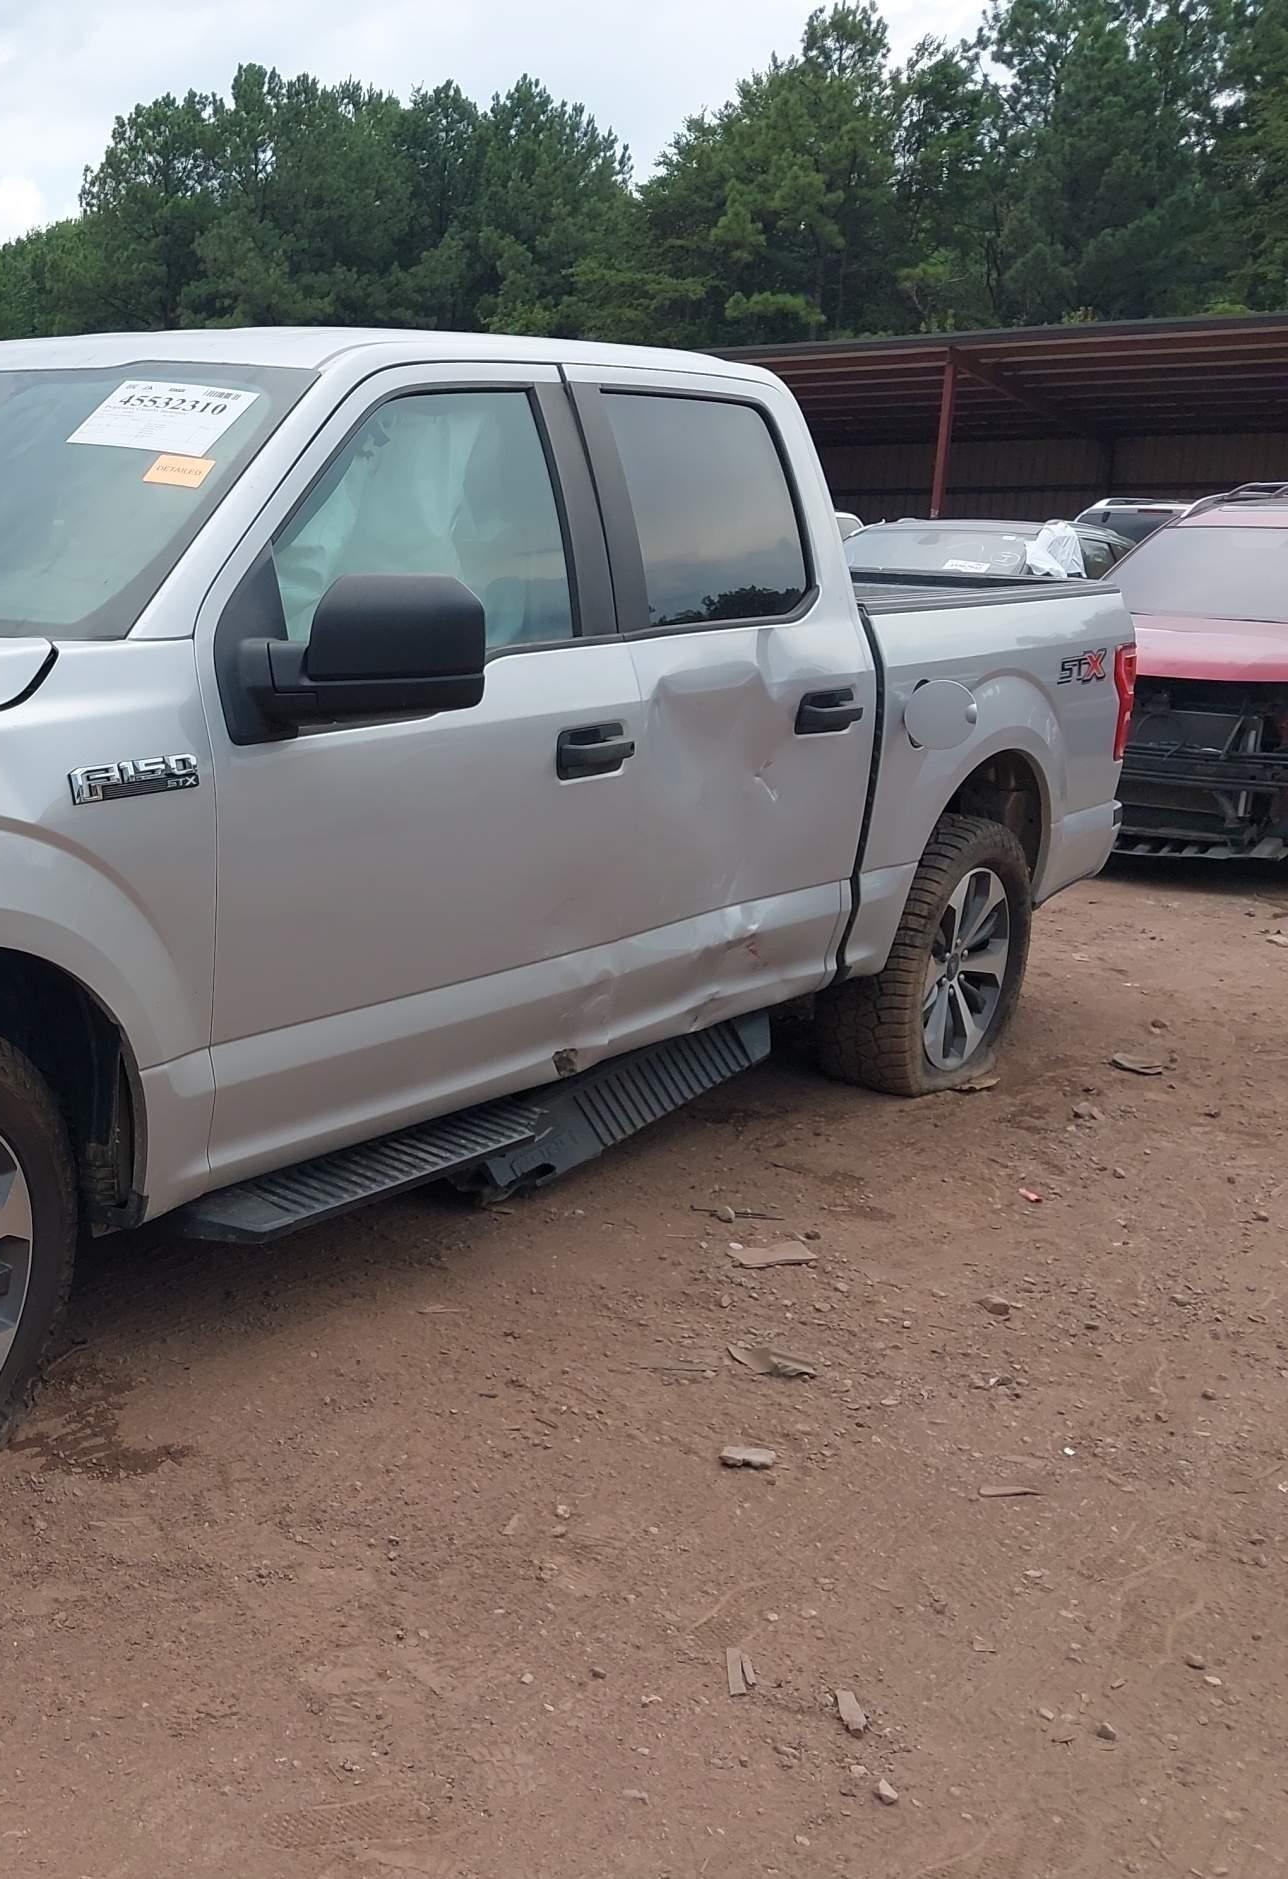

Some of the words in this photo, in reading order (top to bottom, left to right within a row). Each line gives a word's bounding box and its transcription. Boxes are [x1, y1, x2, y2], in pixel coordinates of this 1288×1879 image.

[119, 394, 228, 416] 45532310
[1057, 648, 1107, 685] STX
[167, 775, 197, 788] STX
